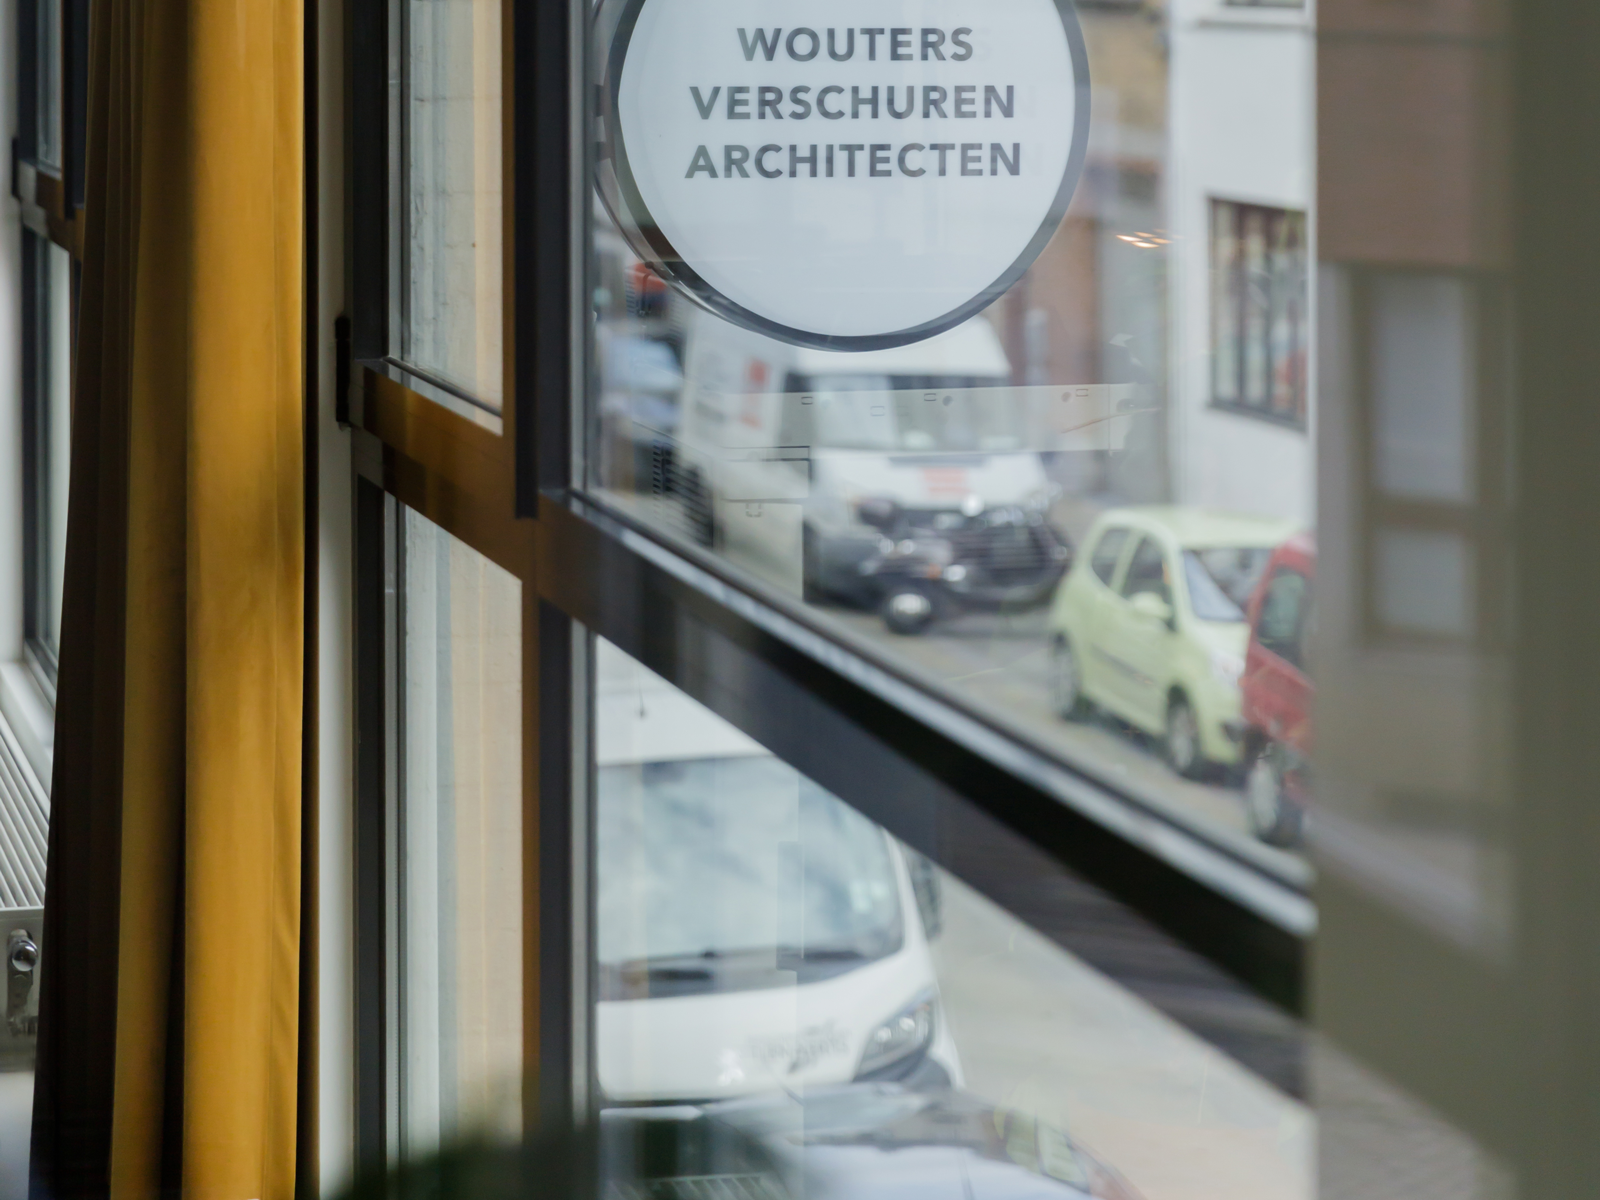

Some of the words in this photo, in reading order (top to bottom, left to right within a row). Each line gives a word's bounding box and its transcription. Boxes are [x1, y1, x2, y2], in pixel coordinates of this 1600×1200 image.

[736, 27, 973, 62] WOUTERS
[689, 85, 1014, 120] VERSCHUREN
[684, 143, 1020, 179] ARCHITECTEN
